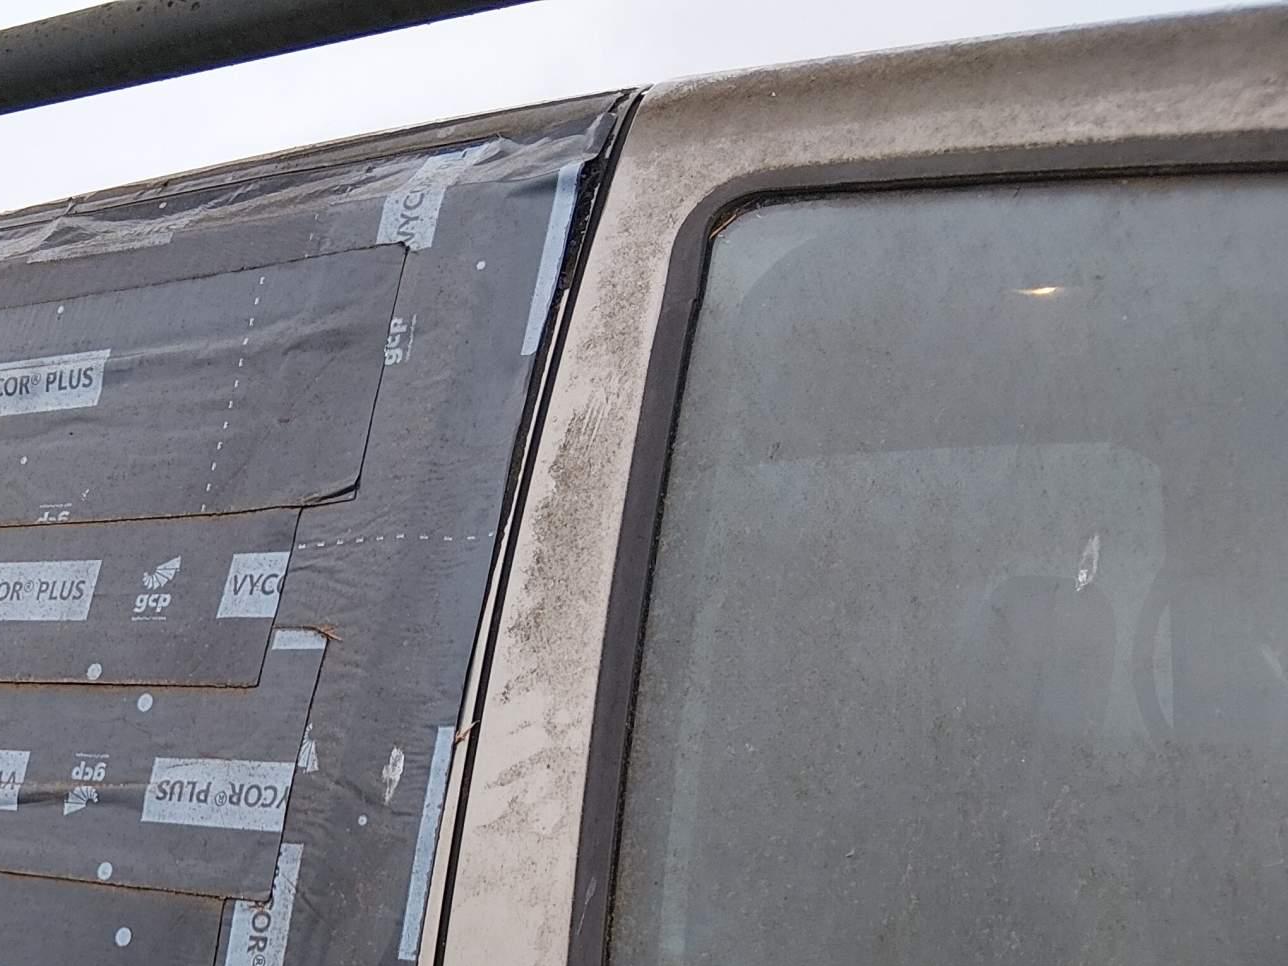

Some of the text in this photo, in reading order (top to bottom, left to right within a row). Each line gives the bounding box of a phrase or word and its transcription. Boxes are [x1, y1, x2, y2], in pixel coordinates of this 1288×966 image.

[44, 366, 94, 394] PLUS
[35, 579, 87, 601] PLUS
[132, 592, 172, 613] gcp
[71, 760, 107, 782] gcp
[155, 779, 212, 805] PLUS
